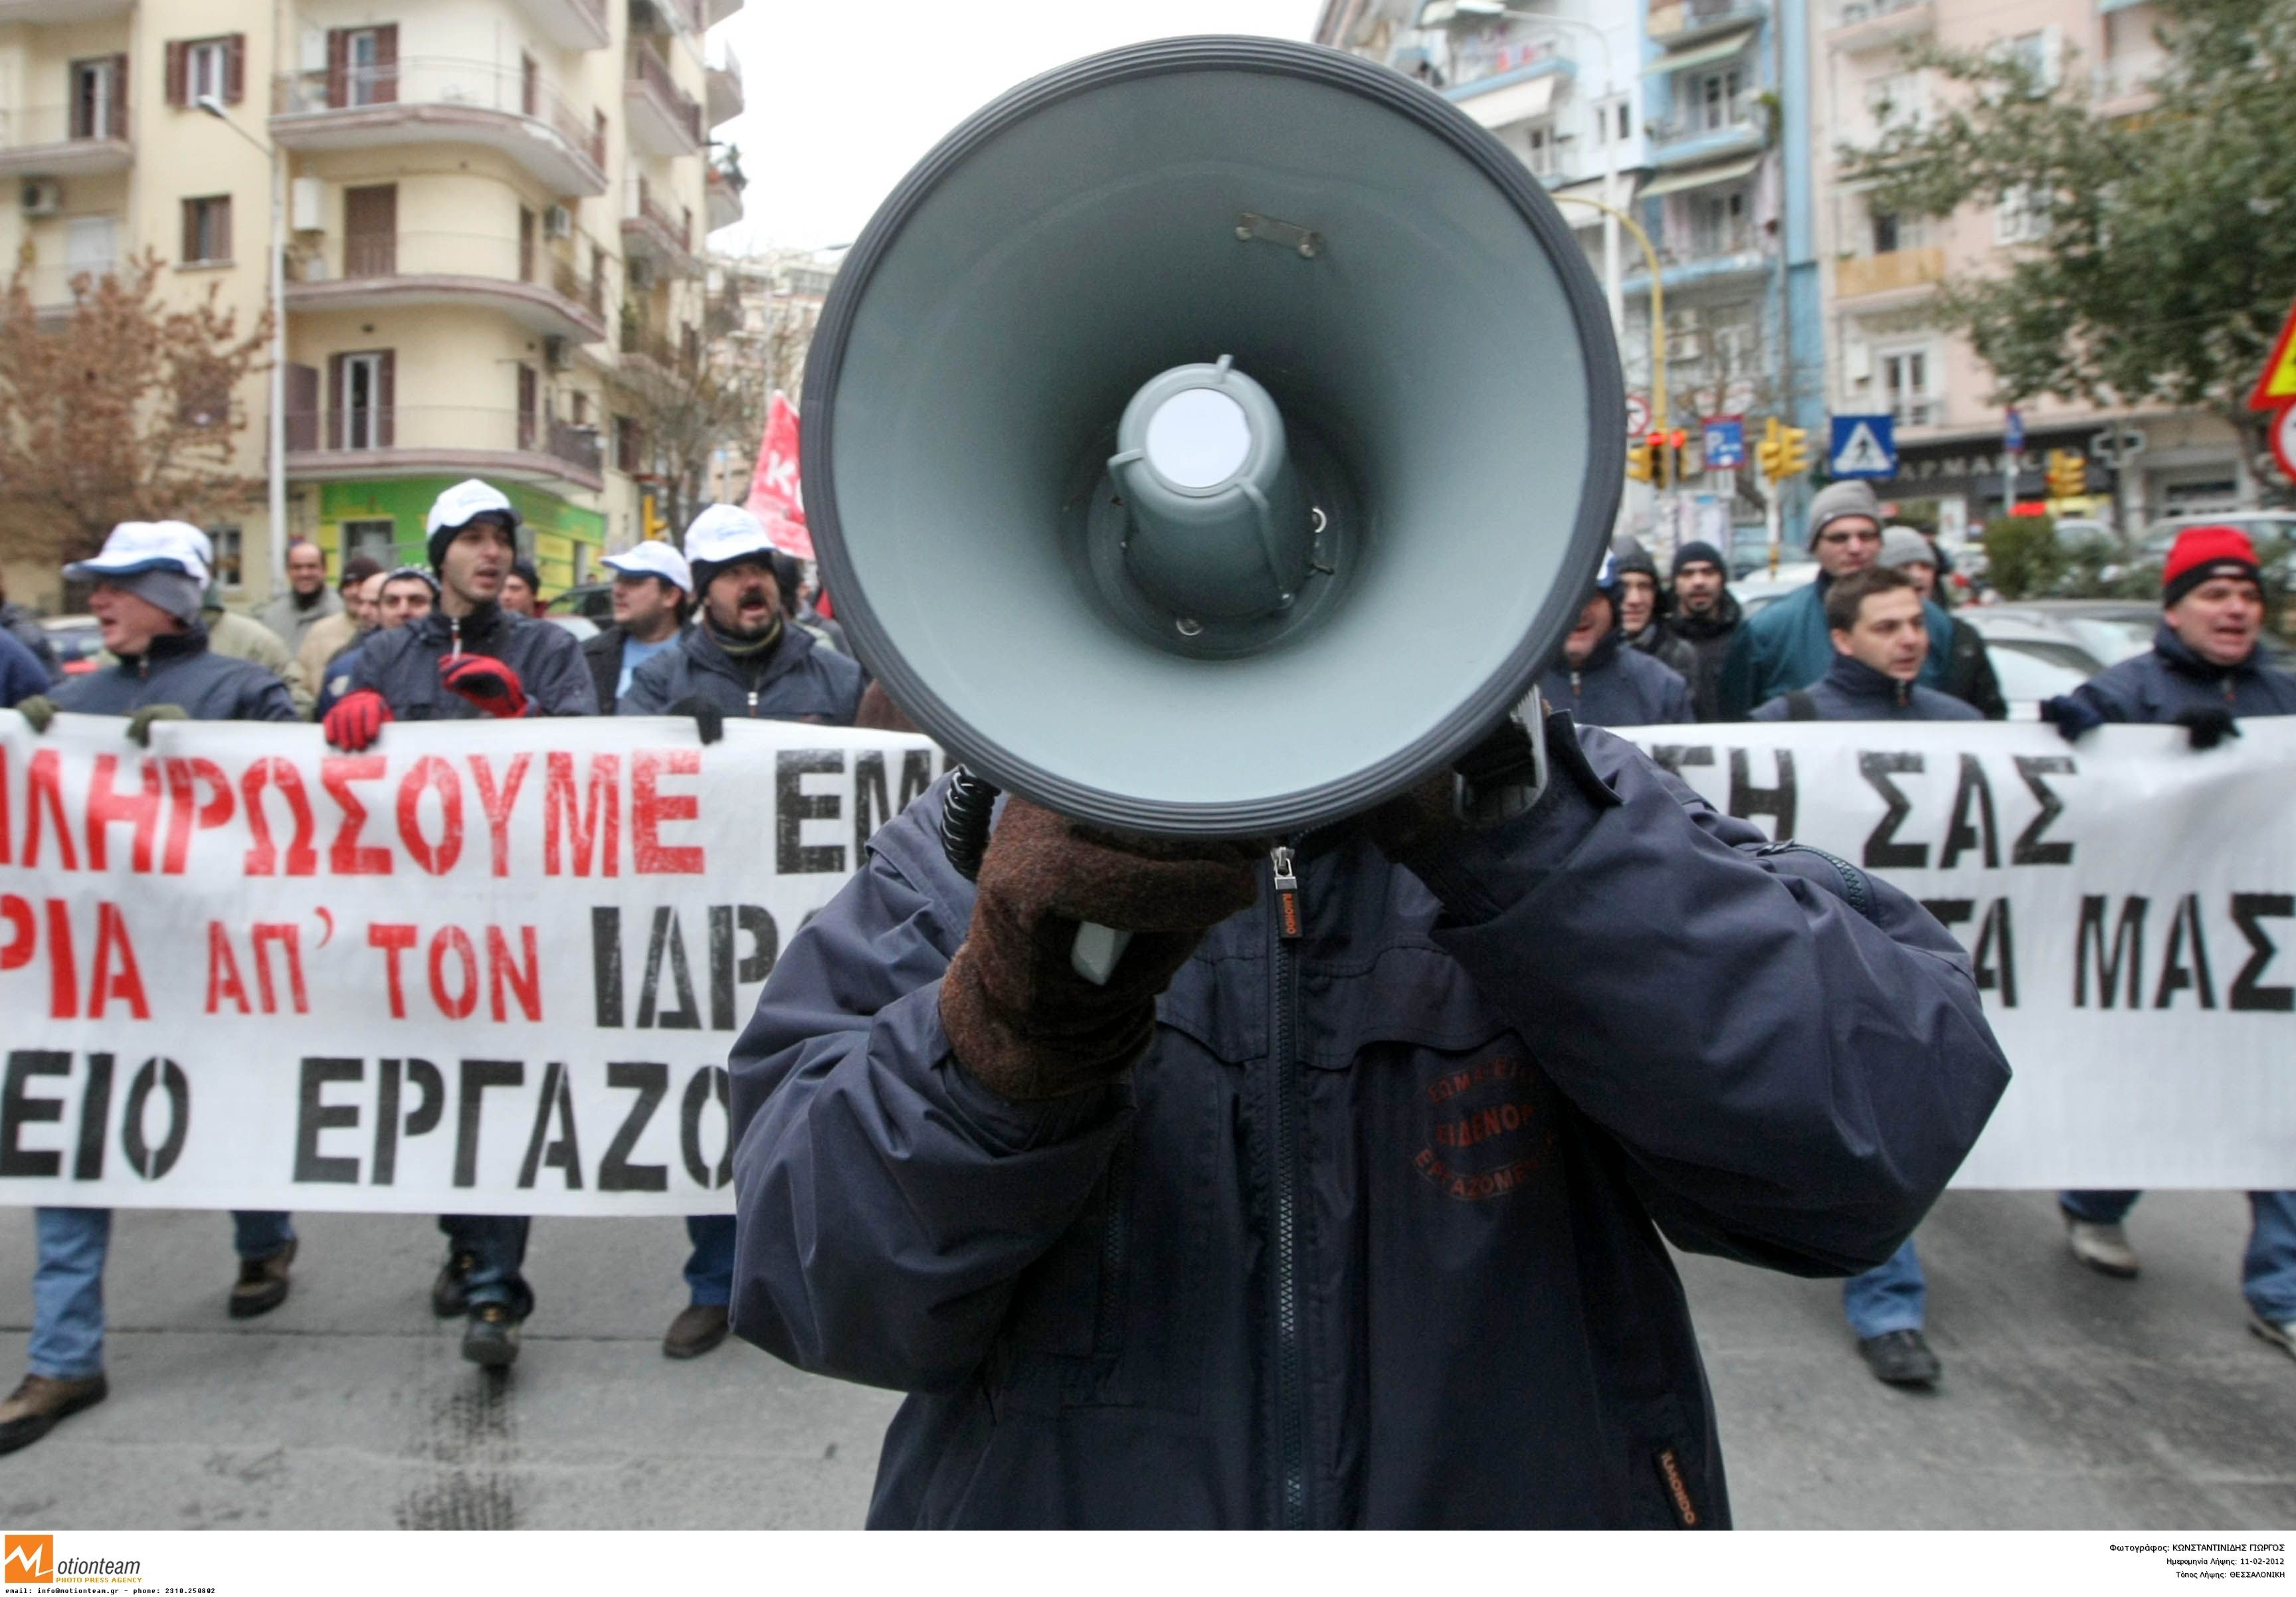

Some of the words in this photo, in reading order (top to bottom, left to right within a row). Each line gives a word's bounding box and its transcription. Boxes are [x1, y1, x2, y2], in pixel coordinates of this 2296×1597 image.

[775, 748, 957, 876] ΕΜ
[1652, 744, 1798, 842] Η
[1859, 749, 2078, 868] ΣΑΣ
[367, 923, 543, 1022] ΤΟΝ
[592, 904, 822, 1031] ΙΔΡ
[2073, 892, 2296, 1012] ΜΑΣ
[0, 1049, 190, 1181] ΕΙΟ
[292, 1057, 733, 1192] ΕΡΓΑΖΟ
